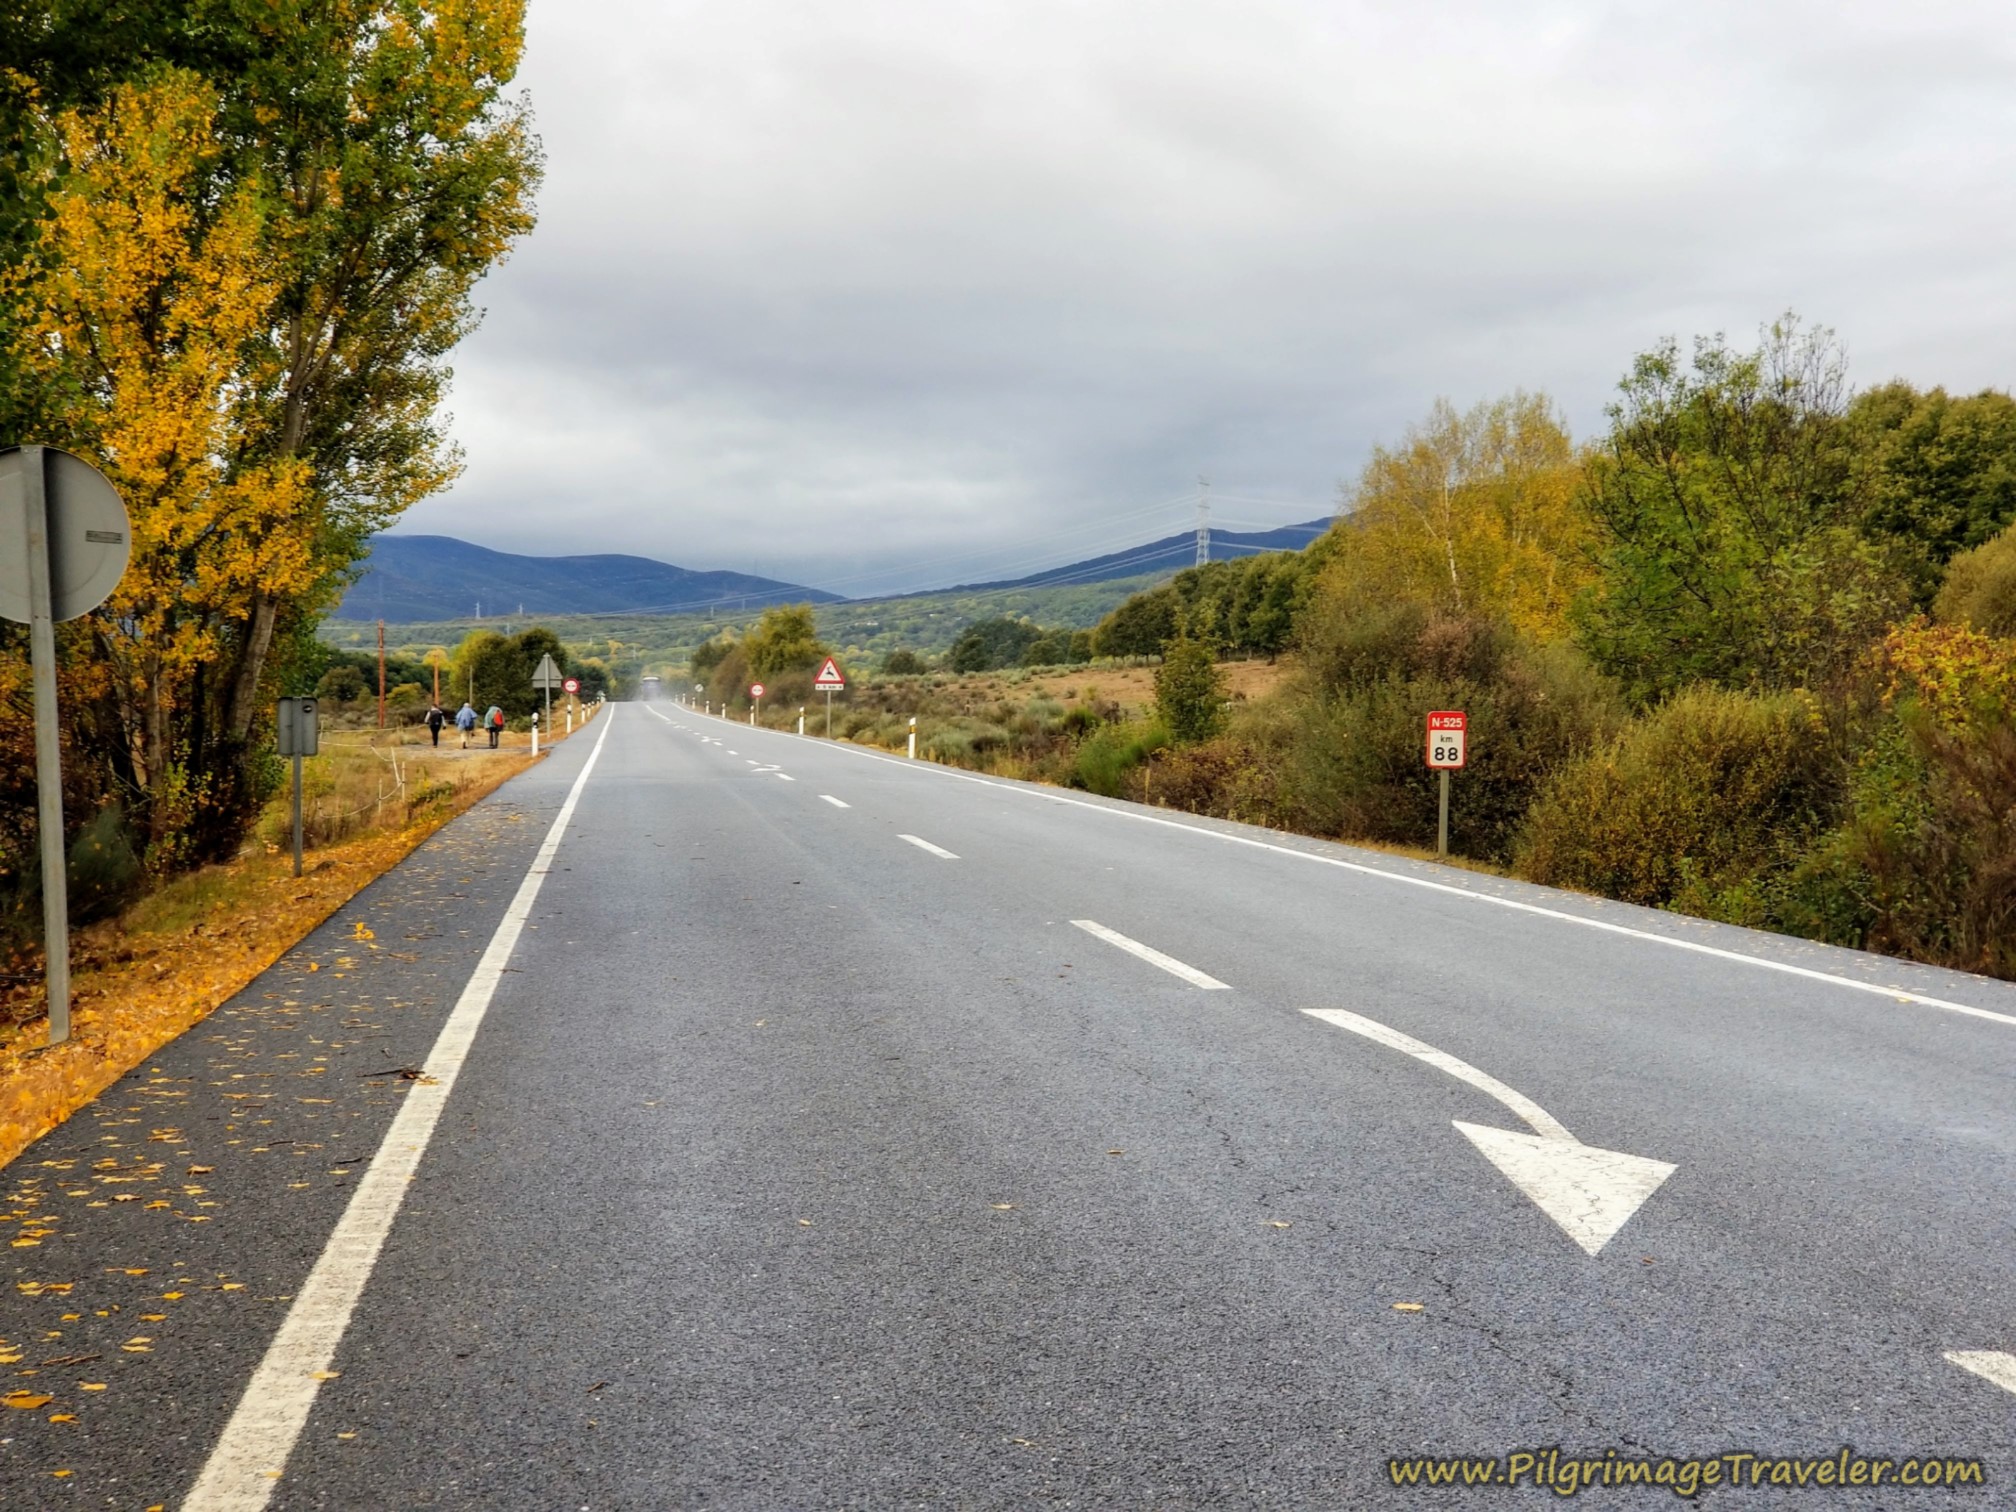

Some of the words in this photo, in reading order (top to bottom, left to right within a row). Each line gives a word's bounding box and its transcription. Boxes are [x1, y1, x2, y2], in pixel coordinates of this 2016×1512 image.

[1432, 717, 1462, 728] N-525
[1440, 734, 1453, 742] km
[1434, 746, 1458, 761] 88
